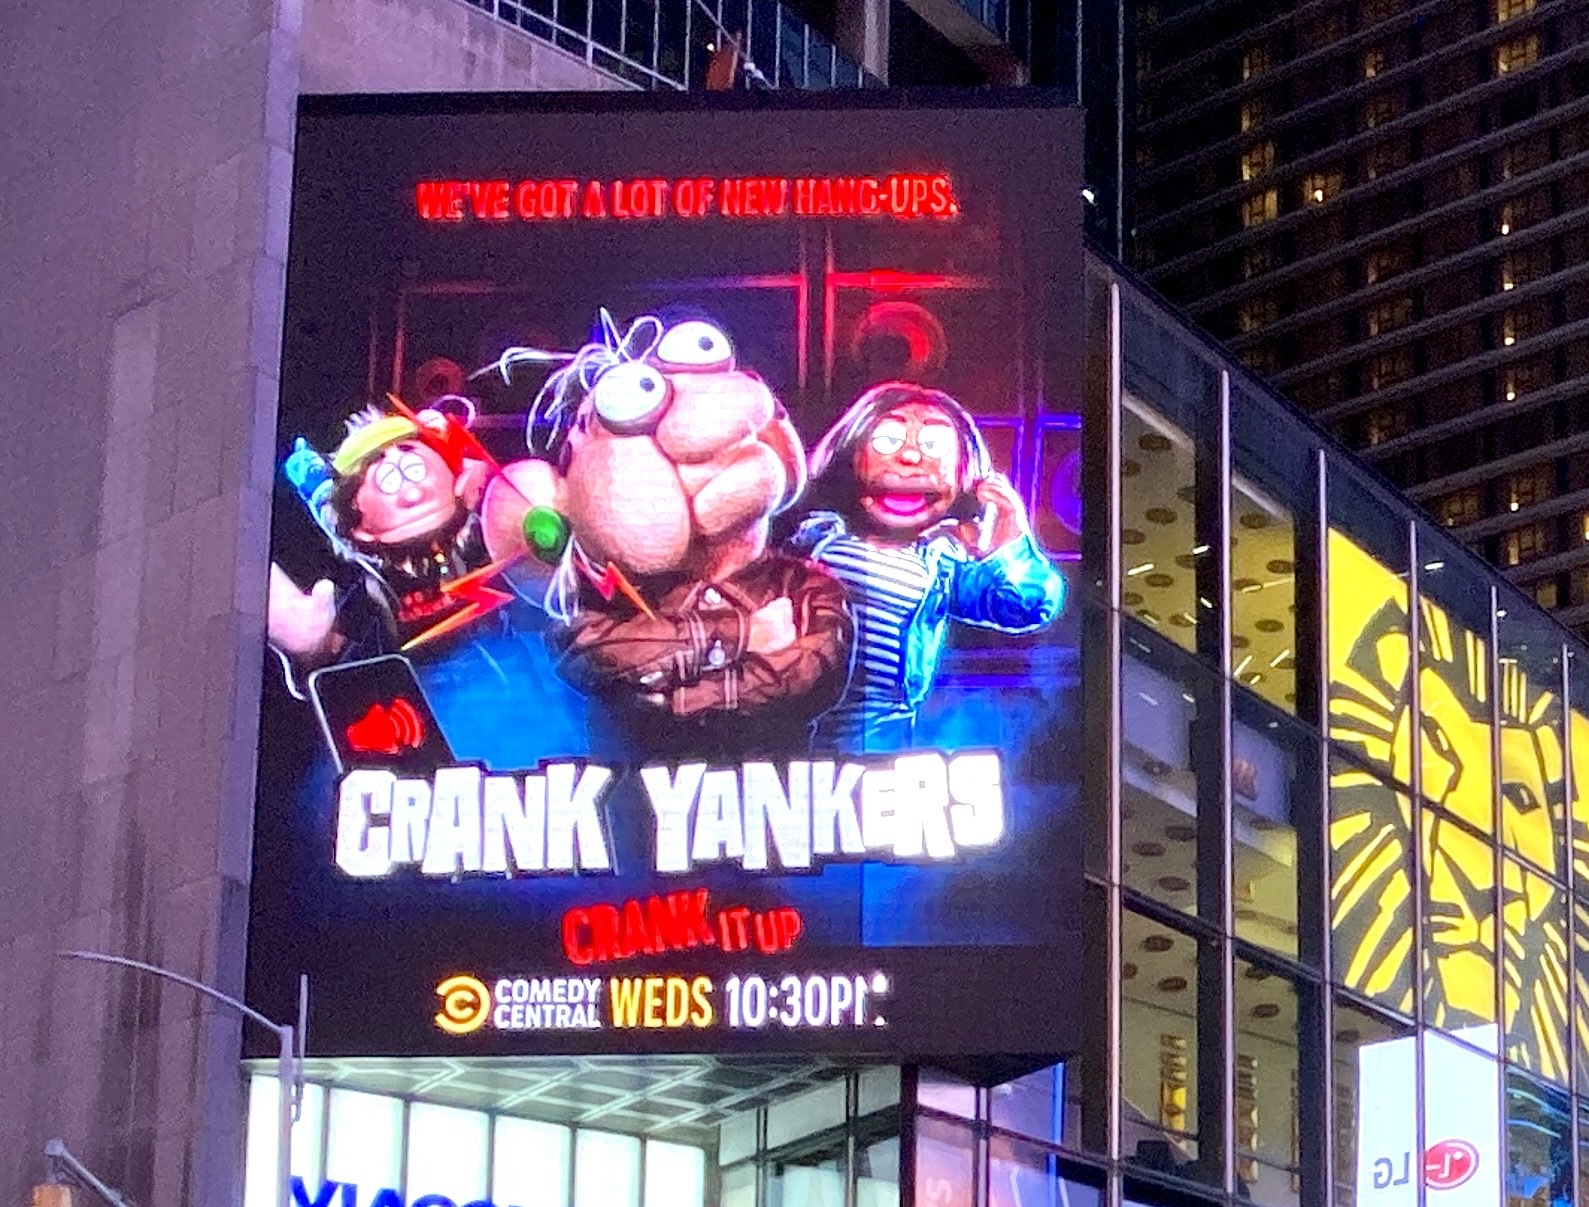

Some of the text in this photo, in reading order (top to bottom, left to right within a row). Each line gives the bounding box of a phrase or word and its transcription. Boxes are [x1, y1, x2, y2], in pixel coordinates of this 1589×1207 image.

[417, 181, 509, 219] WE'VE
[515, 181, 578, 218] GOT
[581, 182, 607, 217] A
[612, 181, 667, 218] LOT
[675, 180, 714, 217] OF
[719, 178, 788, 217] NEW
[335, 751, 1004, 877] CRANK YANKERS
[561, 887, 803, 966] CRANK IT UP
[494, 978, 601, 1003] COMEDY
[609, 976, 714, 1028] WEDS
[494, 1003, 601, 1028] CENTRAL
